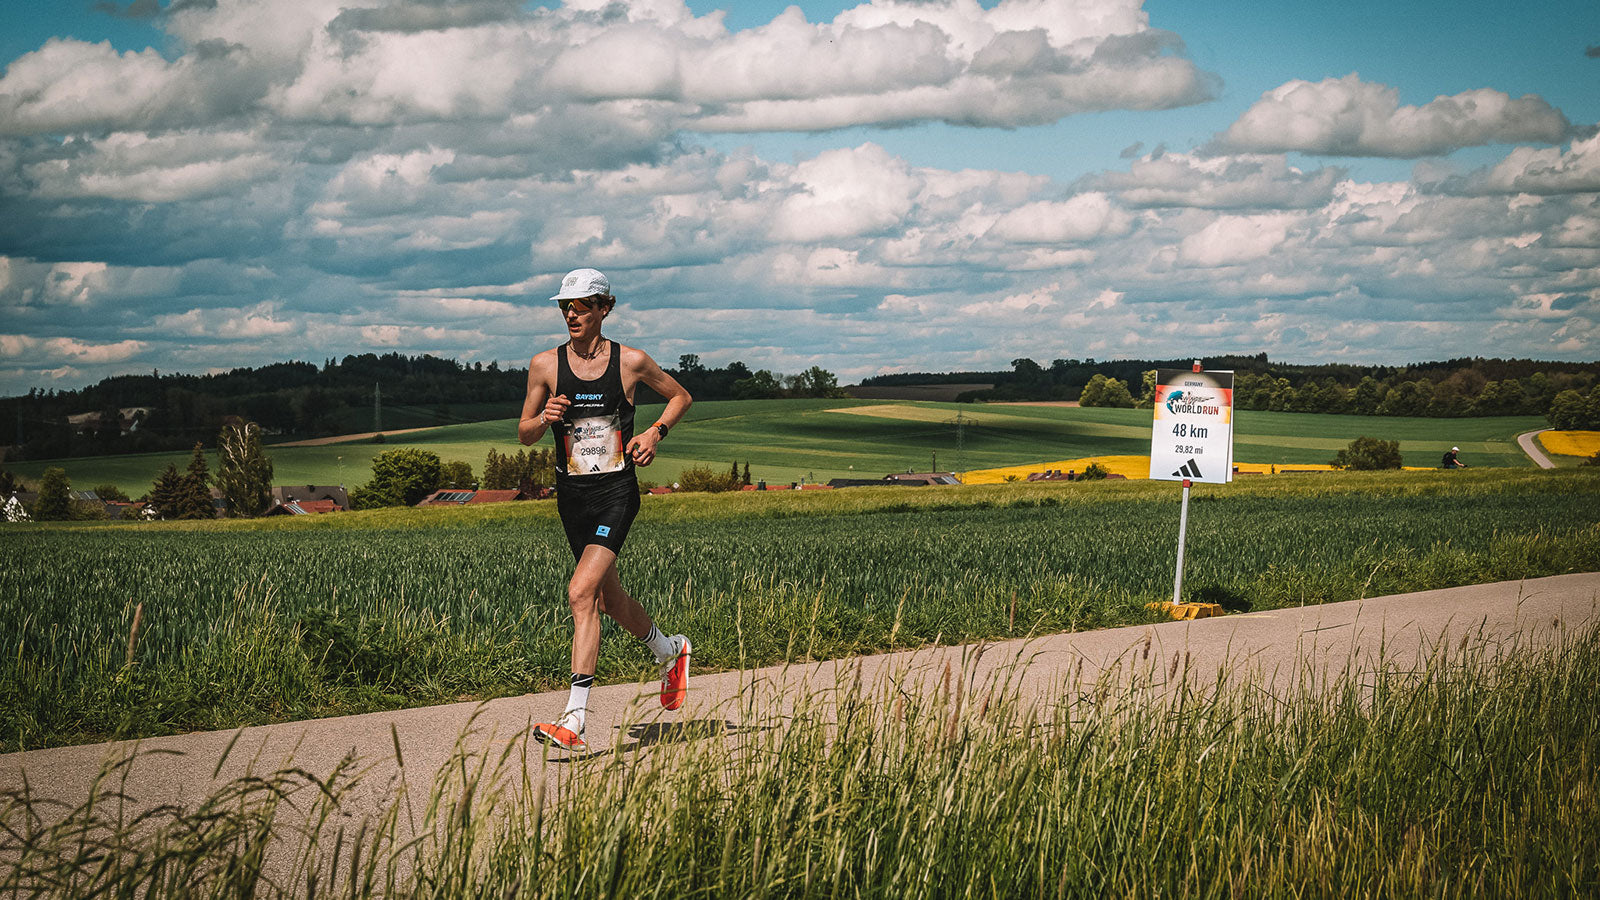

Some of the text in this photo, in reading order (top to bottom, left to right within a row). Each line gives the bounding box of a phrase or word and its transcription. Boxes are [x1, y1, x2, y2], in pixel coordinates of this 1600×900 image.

[1172, 423, 1208, 438] 48 km
[580, 446, 607, 456] 29896
[1194, 446, 1203, 454] mi
